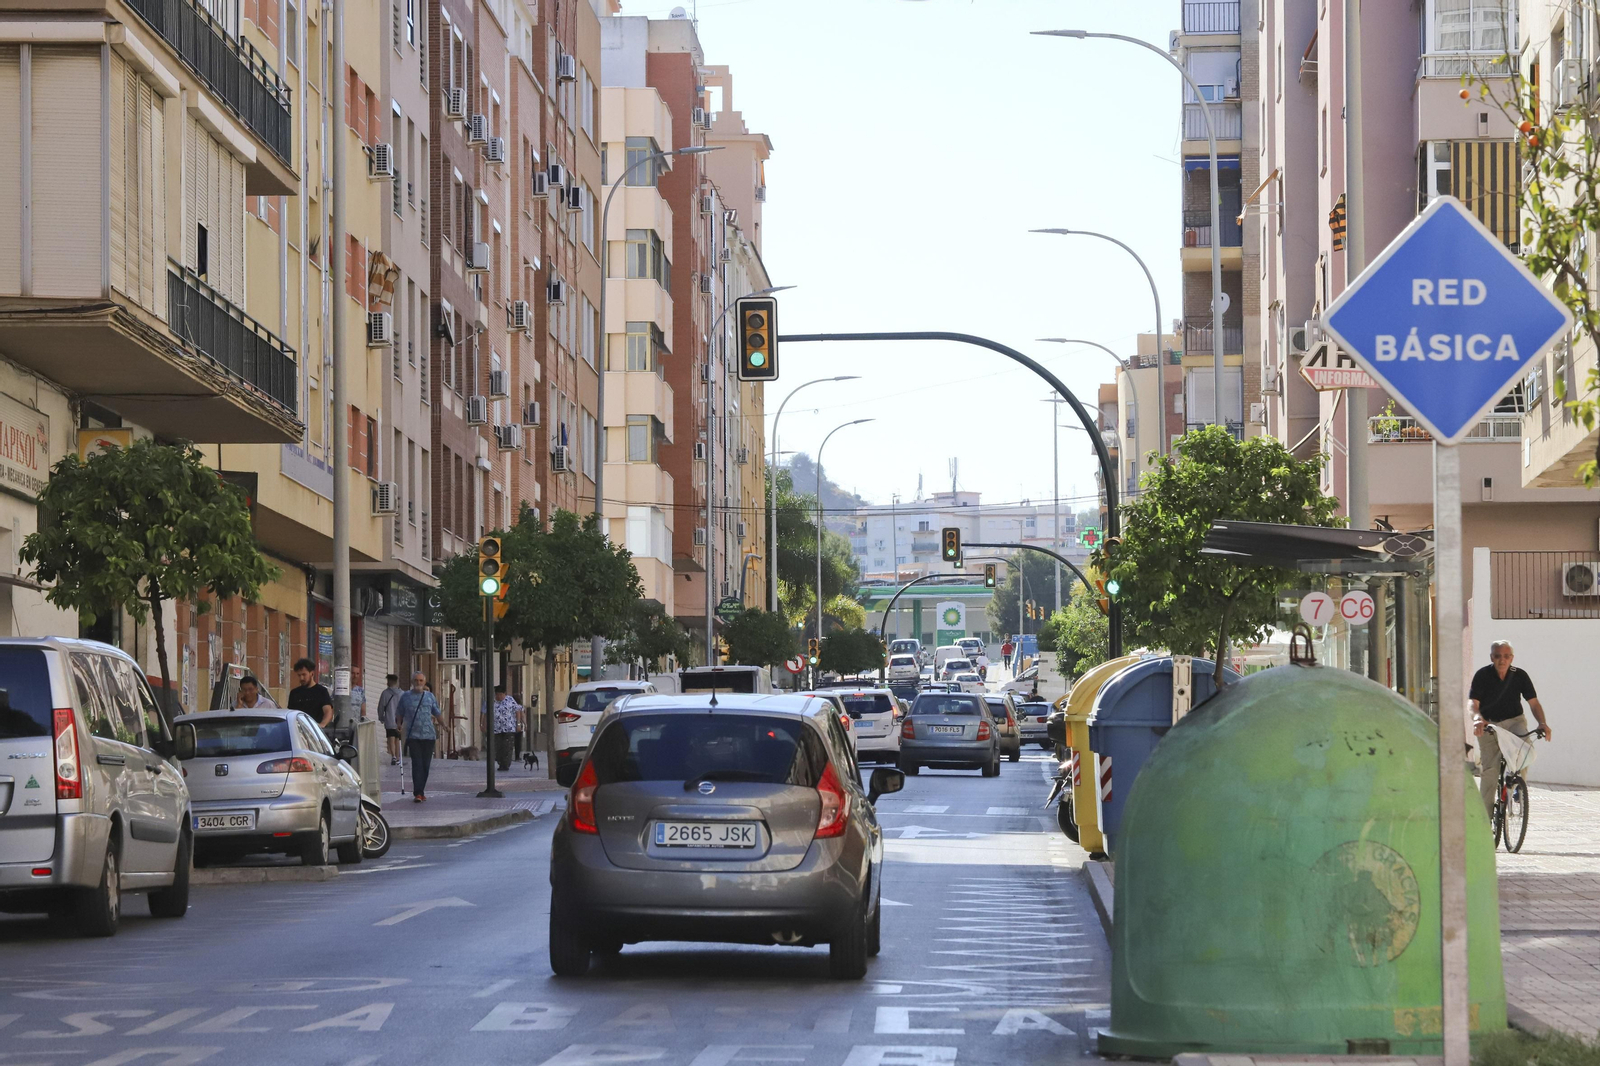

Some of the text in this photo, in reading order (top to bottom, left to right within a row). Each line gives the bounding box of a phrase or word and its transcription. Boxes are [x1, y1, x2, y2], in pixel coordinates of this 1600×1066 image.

[1412, 278, 1487, 306] RED
[1375, 327, 1520, 362] BÁSICA
[1314, 370, 1376, 387] INFORMA
[1310, 597, 1373, 620] 7 C6
[200, 815, 249, 828] 3404 CGR
[668, 825, 713, 842] 2665
[719, 826, 752, 843] JSK
